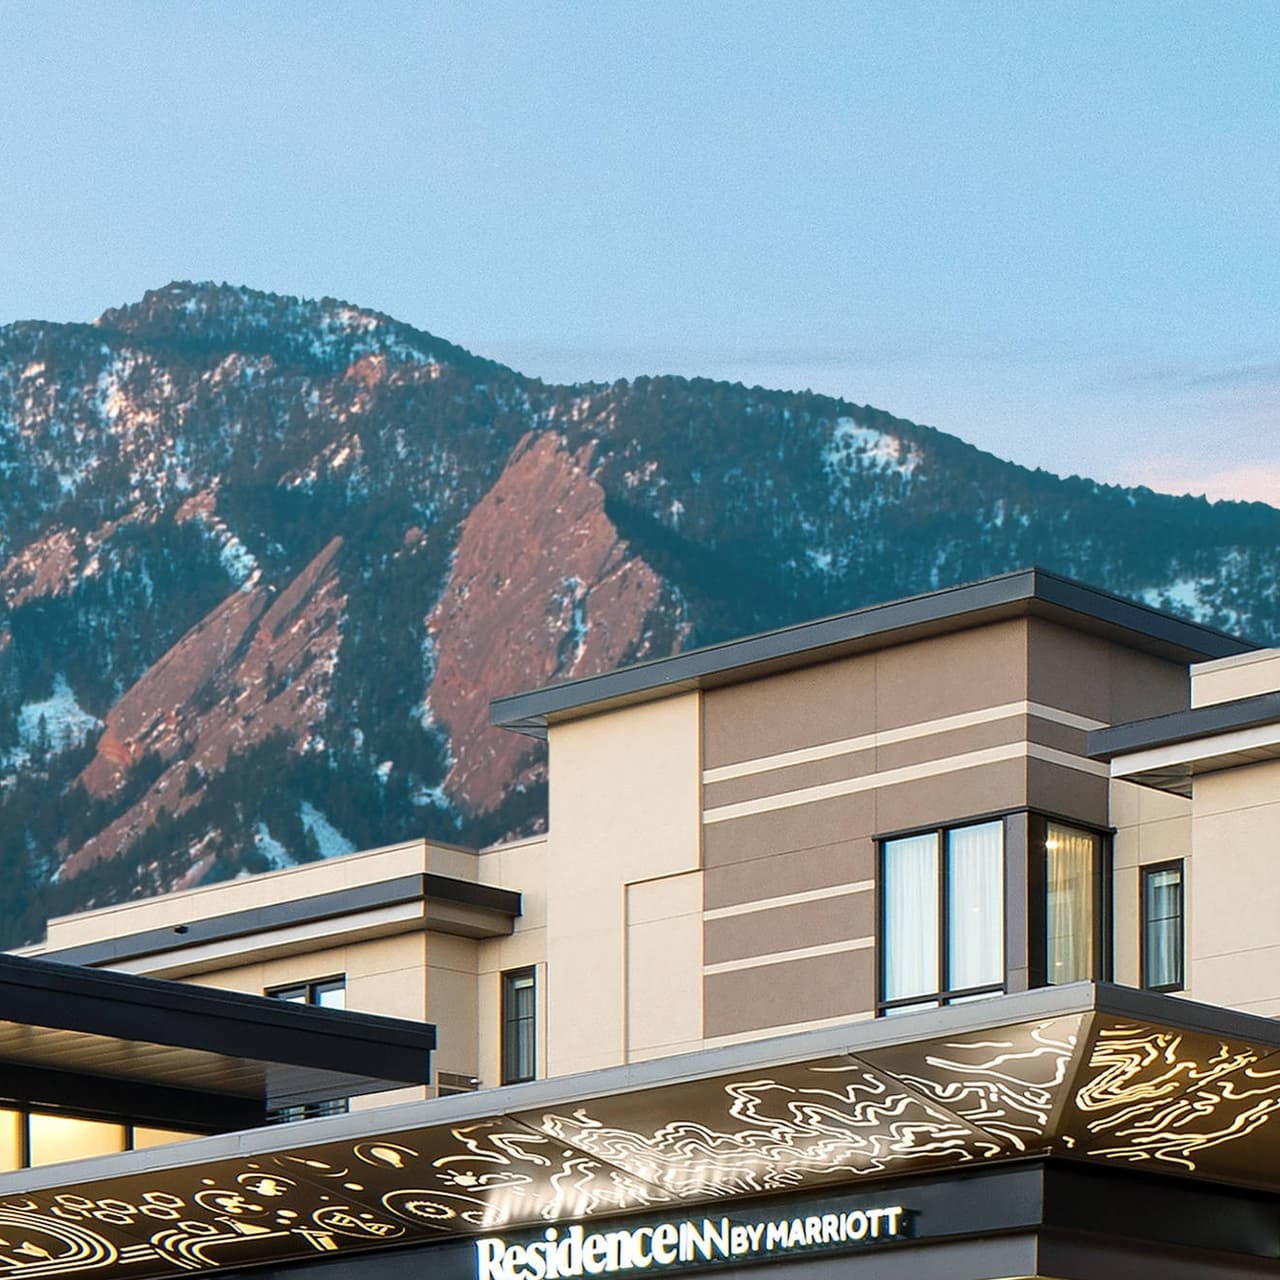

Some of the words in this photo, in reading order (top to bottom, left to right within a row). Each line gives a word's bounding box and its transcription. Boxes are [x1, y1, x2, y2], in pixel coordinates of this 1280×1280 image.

[679, 1216, 730, 1262] INN
[730, 1222, 765, 1255] BY
[765, 1206, 904, 1251] MARRIOTT
